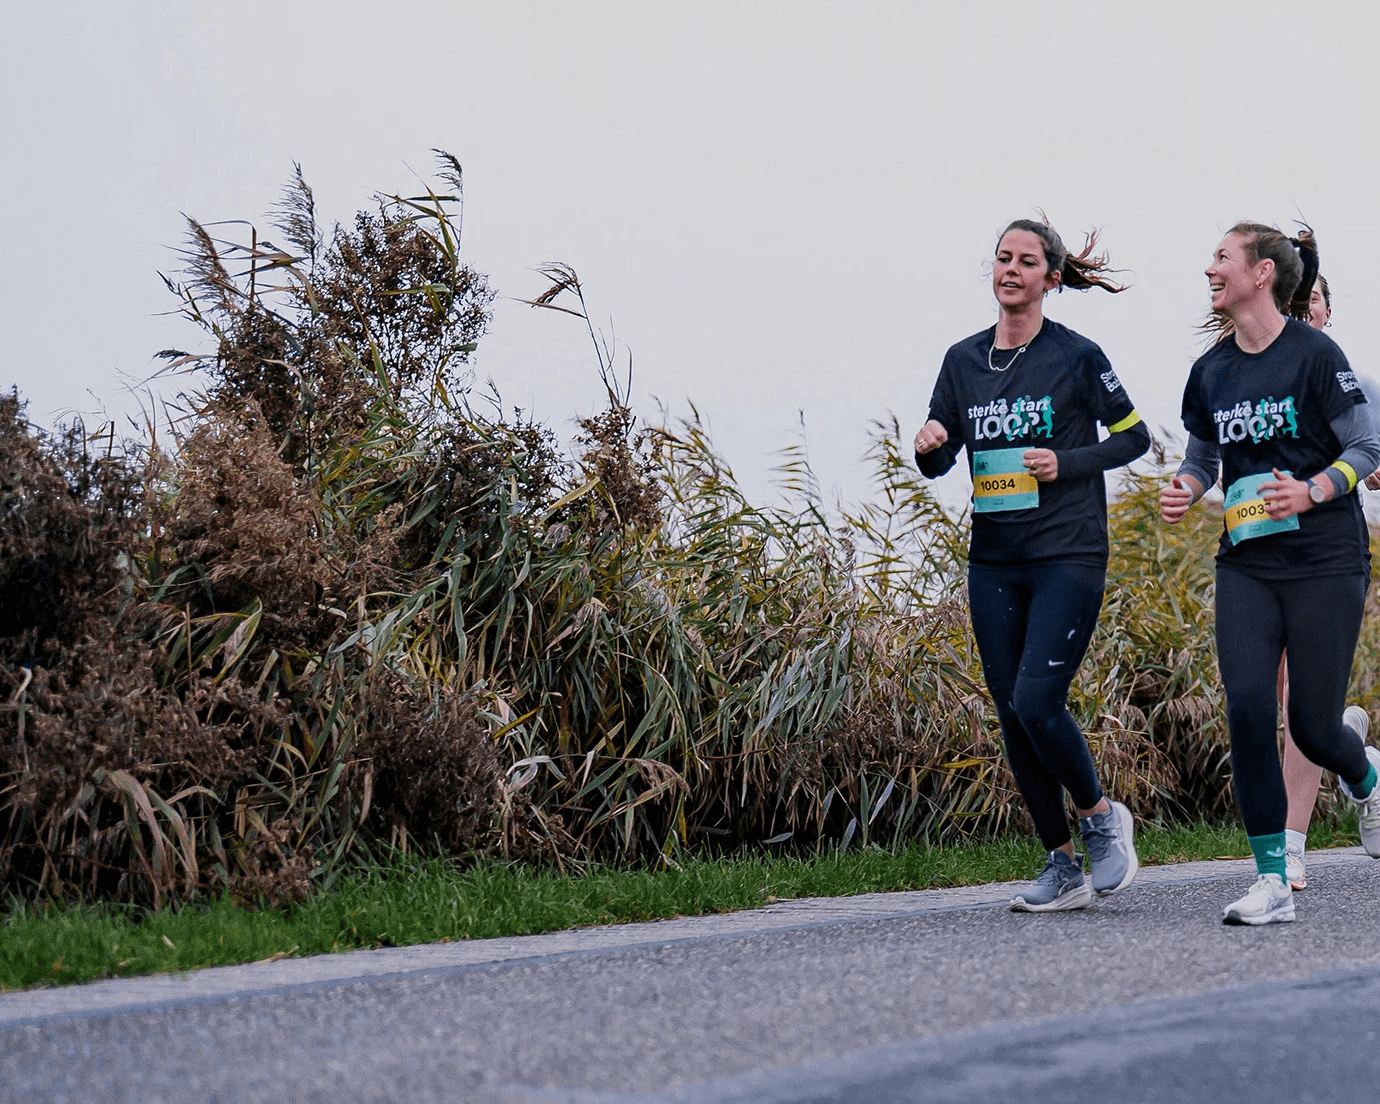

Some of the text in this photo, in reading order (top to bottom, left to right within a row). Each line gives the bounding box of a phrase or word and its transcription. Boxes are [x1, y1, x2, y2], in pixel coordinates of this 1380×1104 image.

[968, 399, 1049, 420] sterke start
[1214, 399, 1291, 424] sterke start
[974, 412, 1041, 441] LOOP
[1217, 413, 1285, 445] LOOP
[980, 478, 1016, 492] 10034
